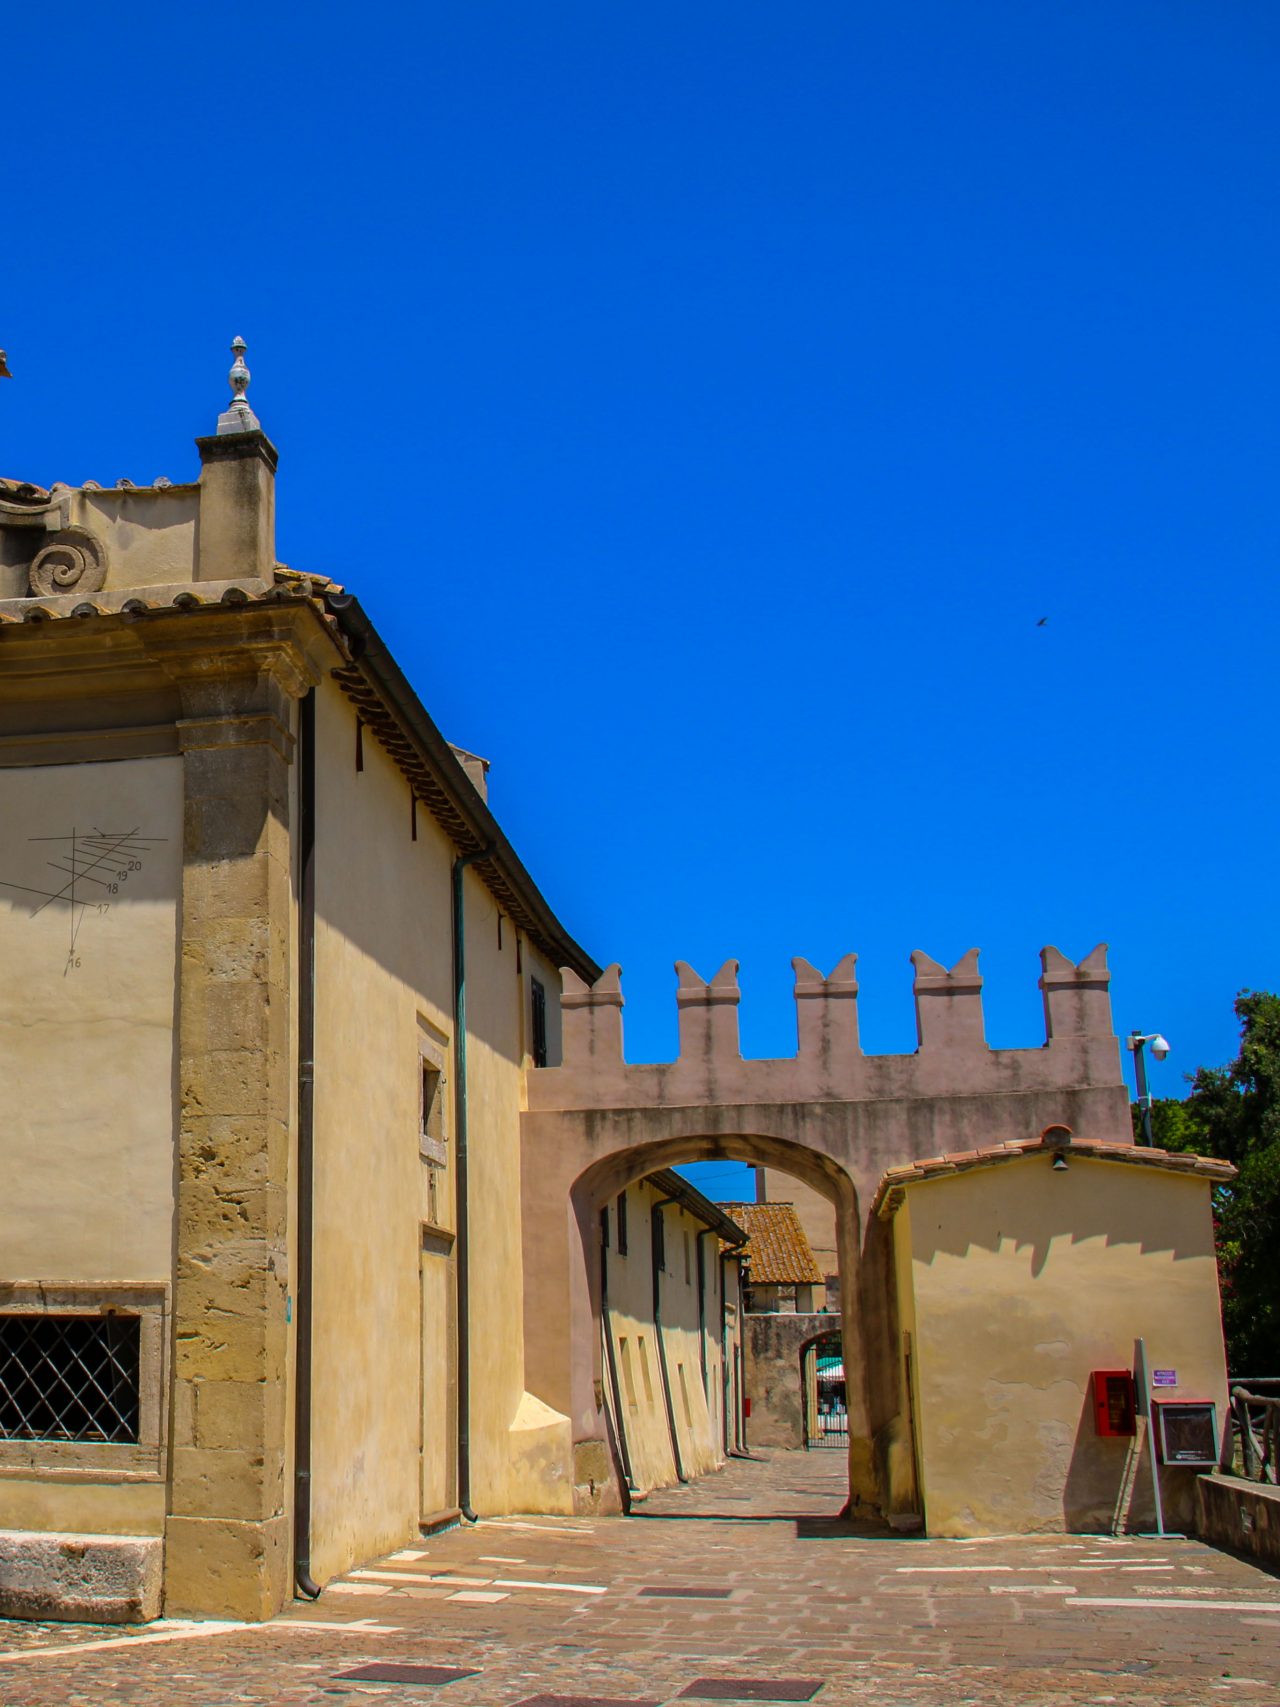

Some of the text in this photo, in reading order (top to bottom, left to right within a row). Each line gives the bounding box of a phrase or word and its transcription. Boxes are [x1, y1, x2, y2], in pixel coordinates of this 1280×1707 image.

[127, 861, 142, 871] 20
[116, 871, 128, 881] 19
[106, 883, 119, 894] 18
[96, 903, 110, 914] 17
[68, 957, 81, 968] 16
